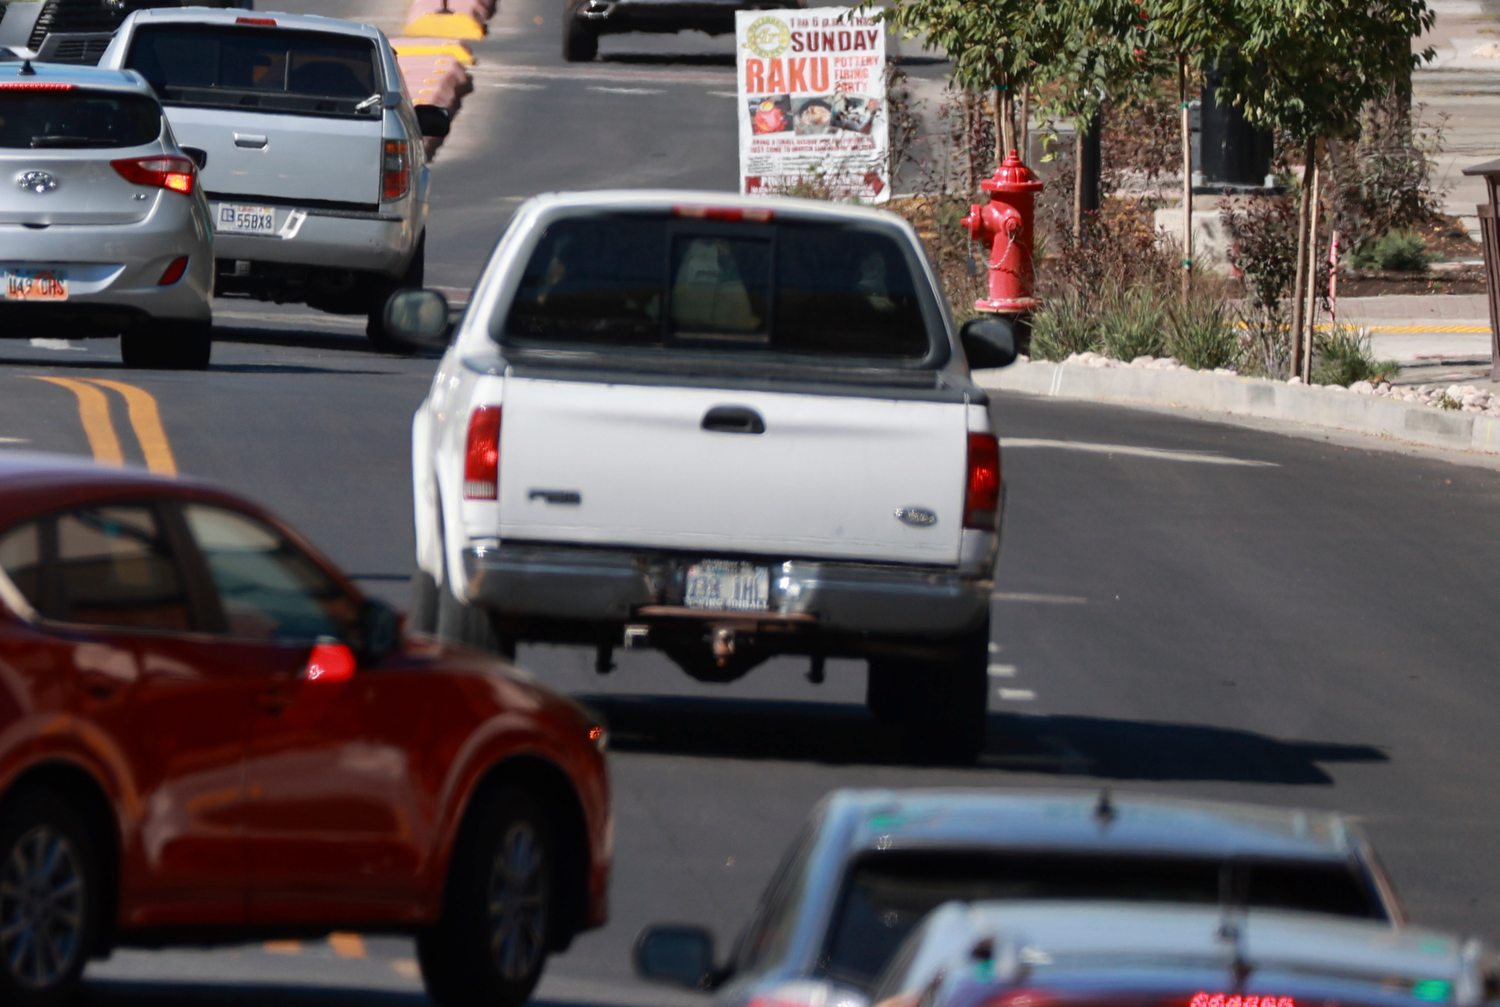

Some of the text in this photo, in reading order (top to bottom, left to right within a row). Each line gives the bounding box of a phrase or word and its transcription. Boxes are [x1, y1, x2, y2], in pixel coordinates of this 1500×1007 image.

[791, 30, 879, 53] SUNDAY
[833, 55, 880, 68] POTTERY
[746, 56, 830, 94] RAKU
[834, 68, 869, 81] FIRING
[835, 81, 869, 93] PARTY
